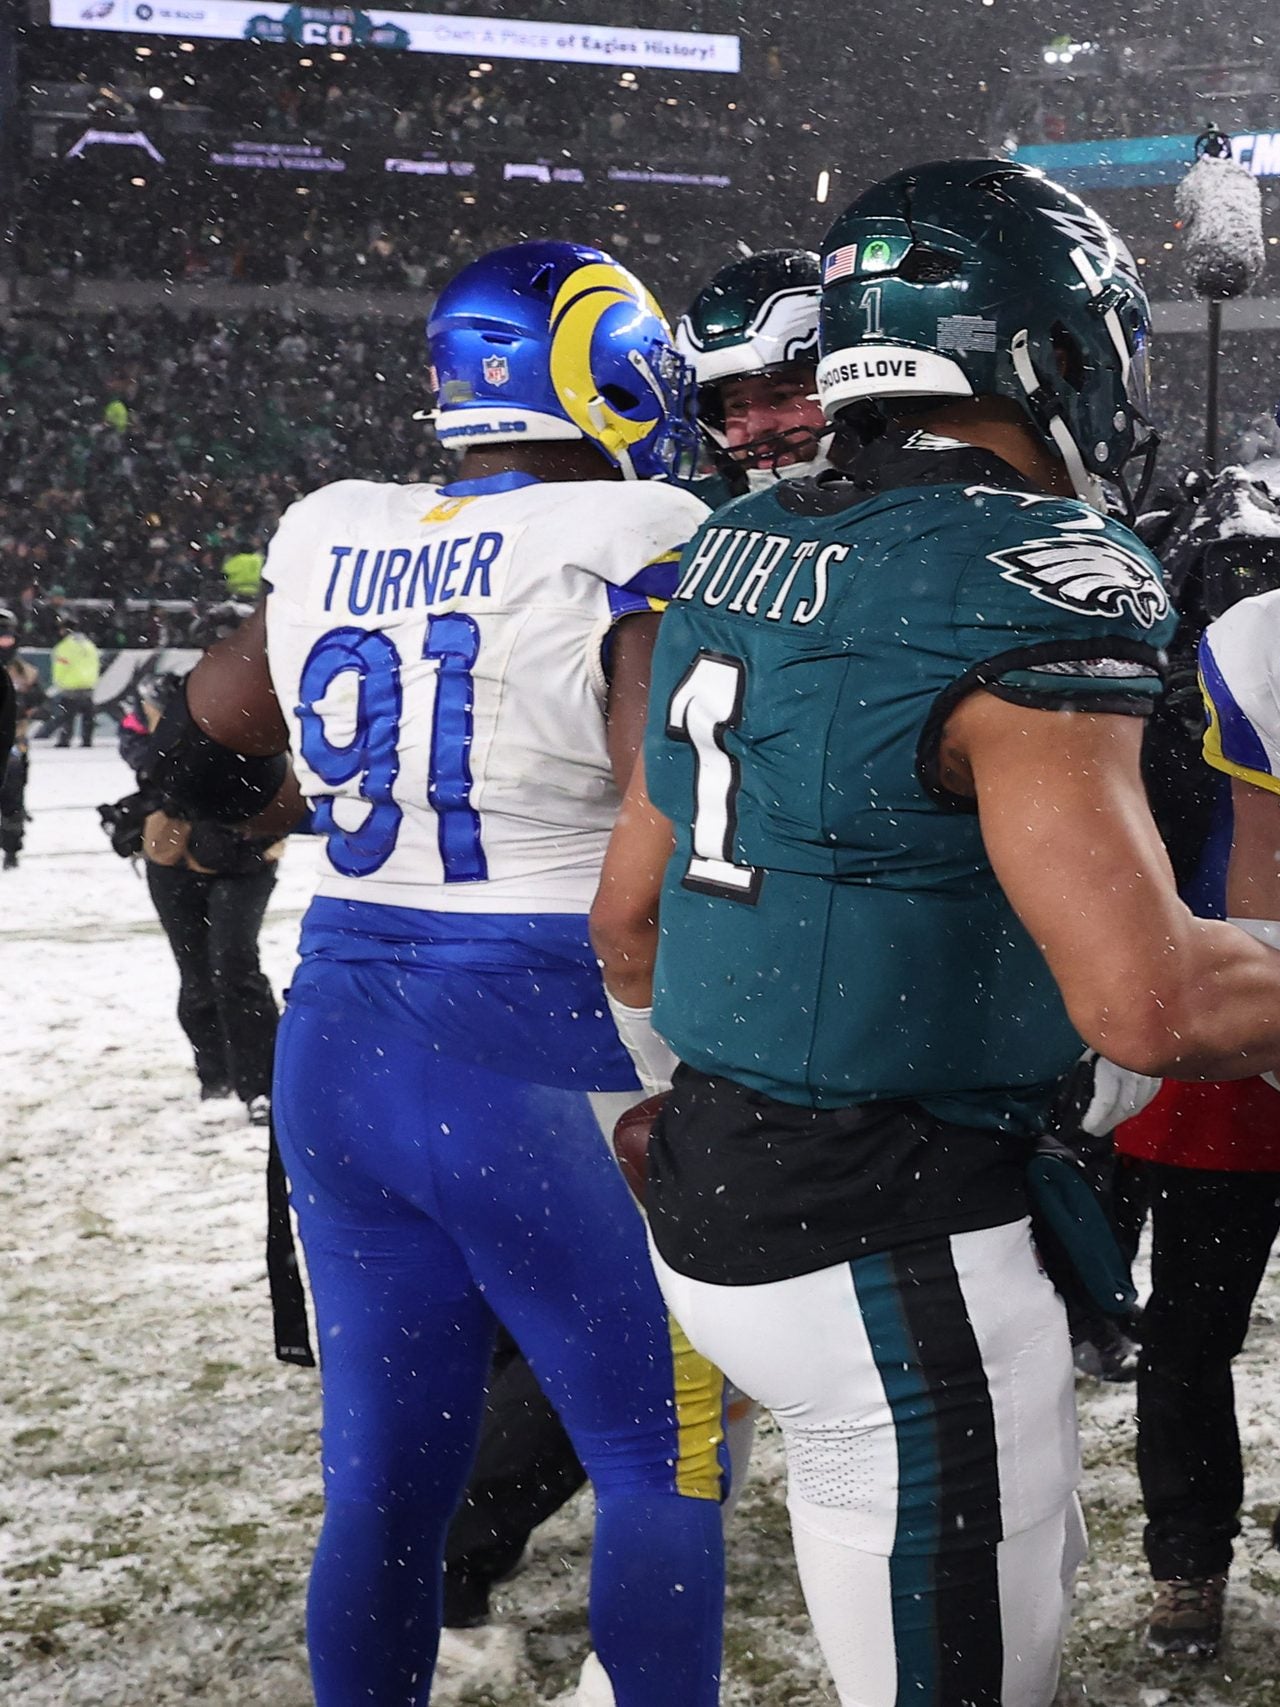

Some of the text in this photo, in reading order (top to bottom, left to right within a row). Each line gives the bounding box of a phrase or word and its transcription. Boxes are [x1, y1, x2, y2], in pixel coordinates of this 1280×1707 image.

[581, 35, 637, 54] Eagles
[859, 287, 884, 339] 1
[864, 360, 917, 379] LOVE
[325, 531, 503, 617] TURNER
[672, 527, 850, 625] HURTS
[294, 611, 488, 883] 91
[667, 648, 763, 905] 1
